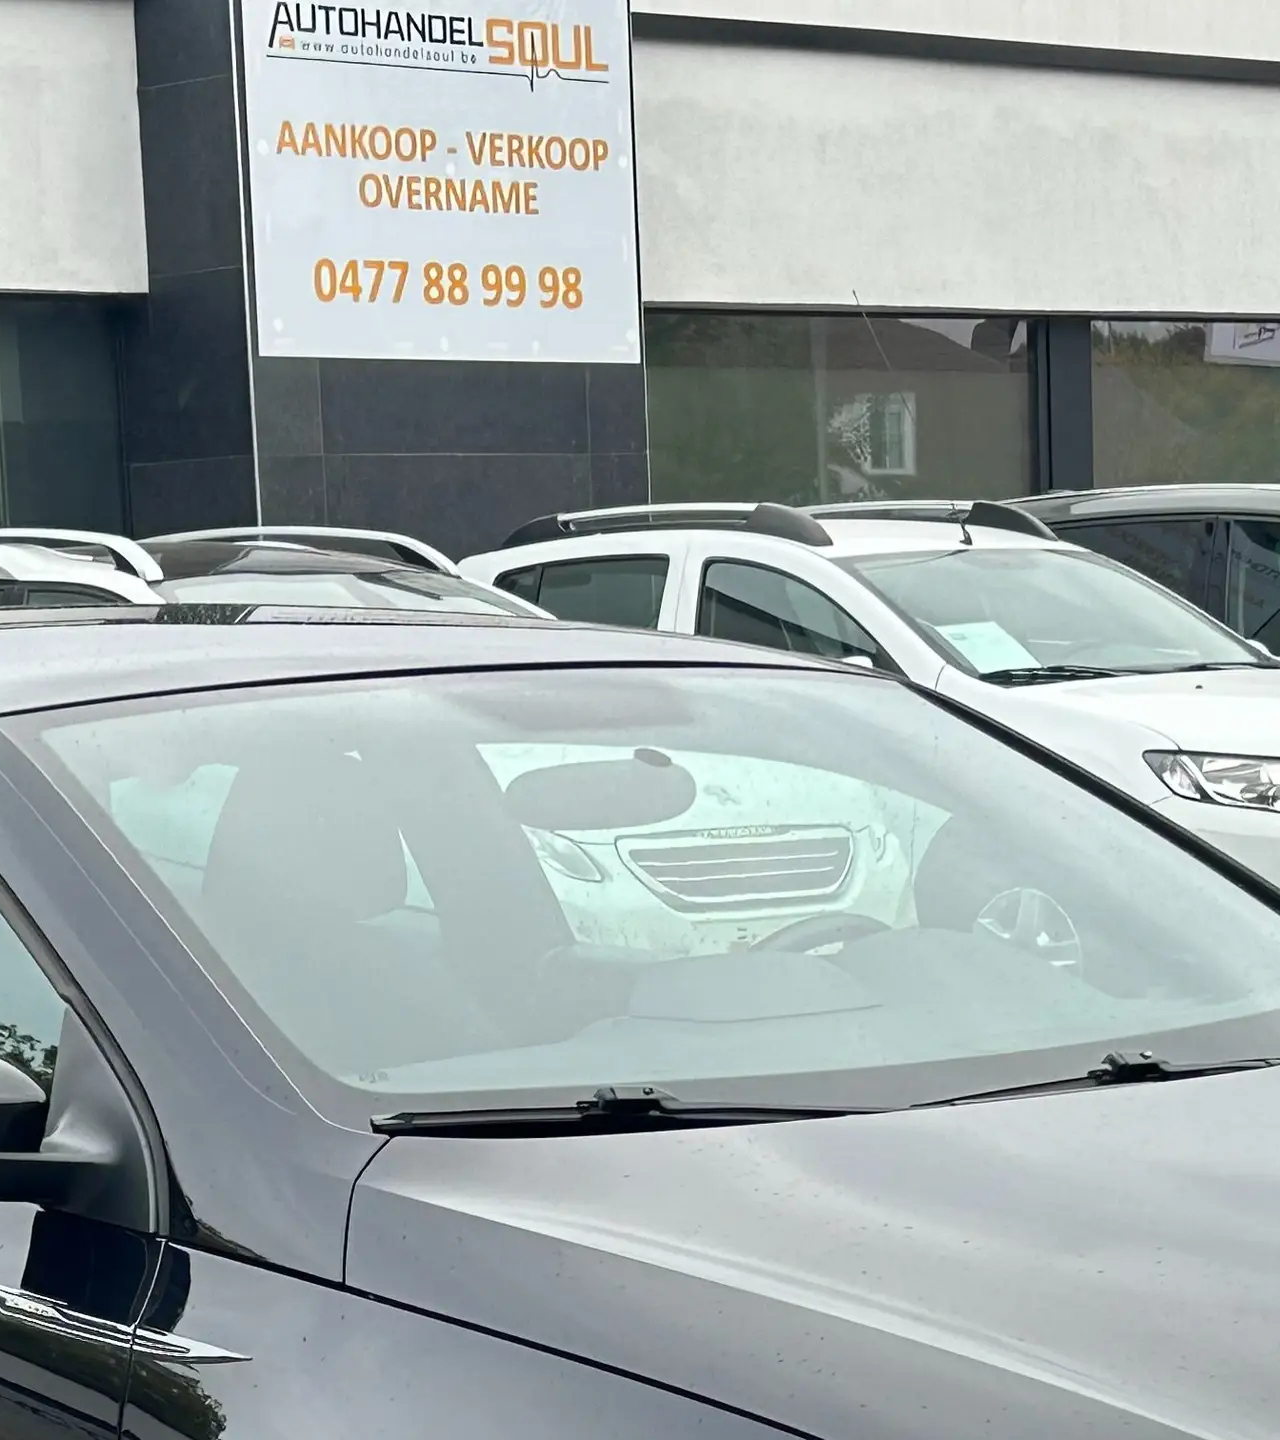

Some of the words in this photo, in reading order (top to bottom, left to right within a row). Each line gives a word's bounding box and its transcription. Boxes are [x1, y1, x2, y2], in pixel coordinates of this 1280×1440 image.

[276, 120, 437, 162] AANKOOP
[465, 131, 609, 171] VERKOOP
[359, 174, 539, 215] OVERNAME
[314, 257, 409, 303] 0477
[423, 262, 469, 306] 88
[481, 264, 526, 308] 99
[538, 266, 583, 309] 98
